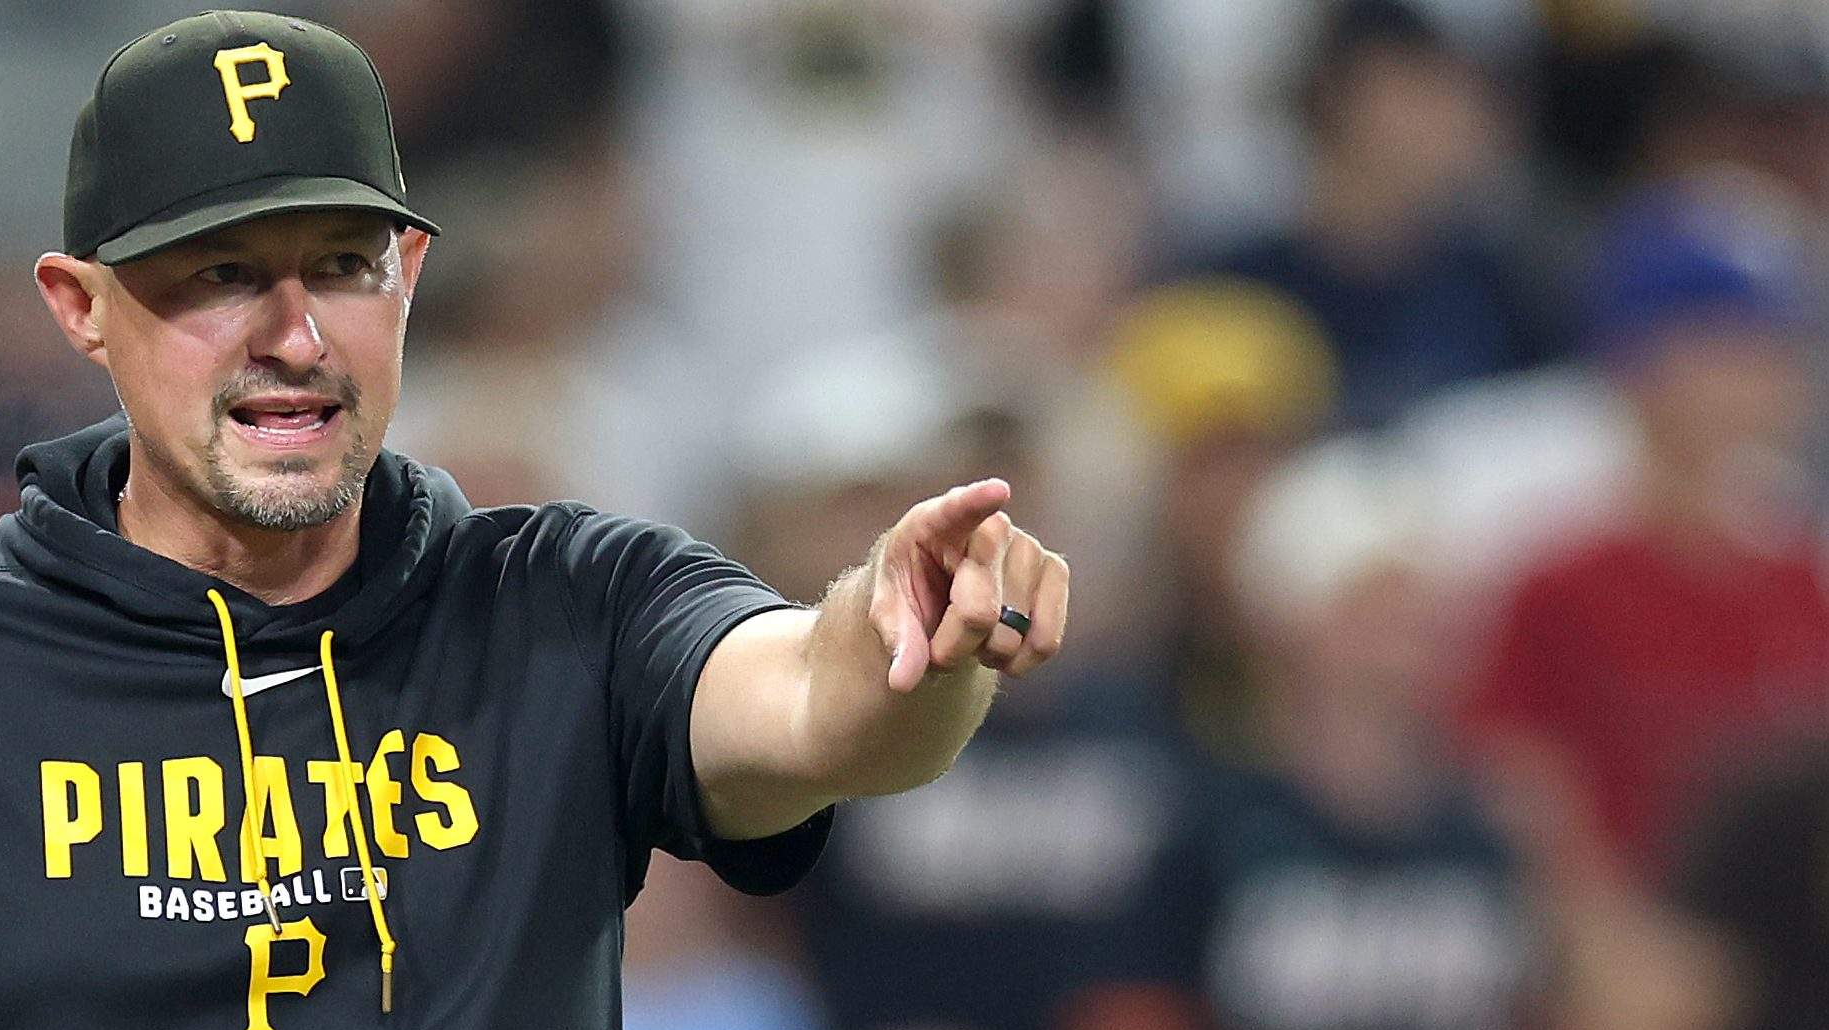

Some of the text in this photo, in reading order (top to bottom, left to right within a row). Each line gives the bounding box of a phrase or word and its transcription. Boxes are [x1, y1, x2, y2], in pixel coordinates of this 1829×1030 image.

[213, 42, 291, 144] P
[40, 730, 479, 883] PIRATES
[139, 869, 332, 923] BASEBALL
